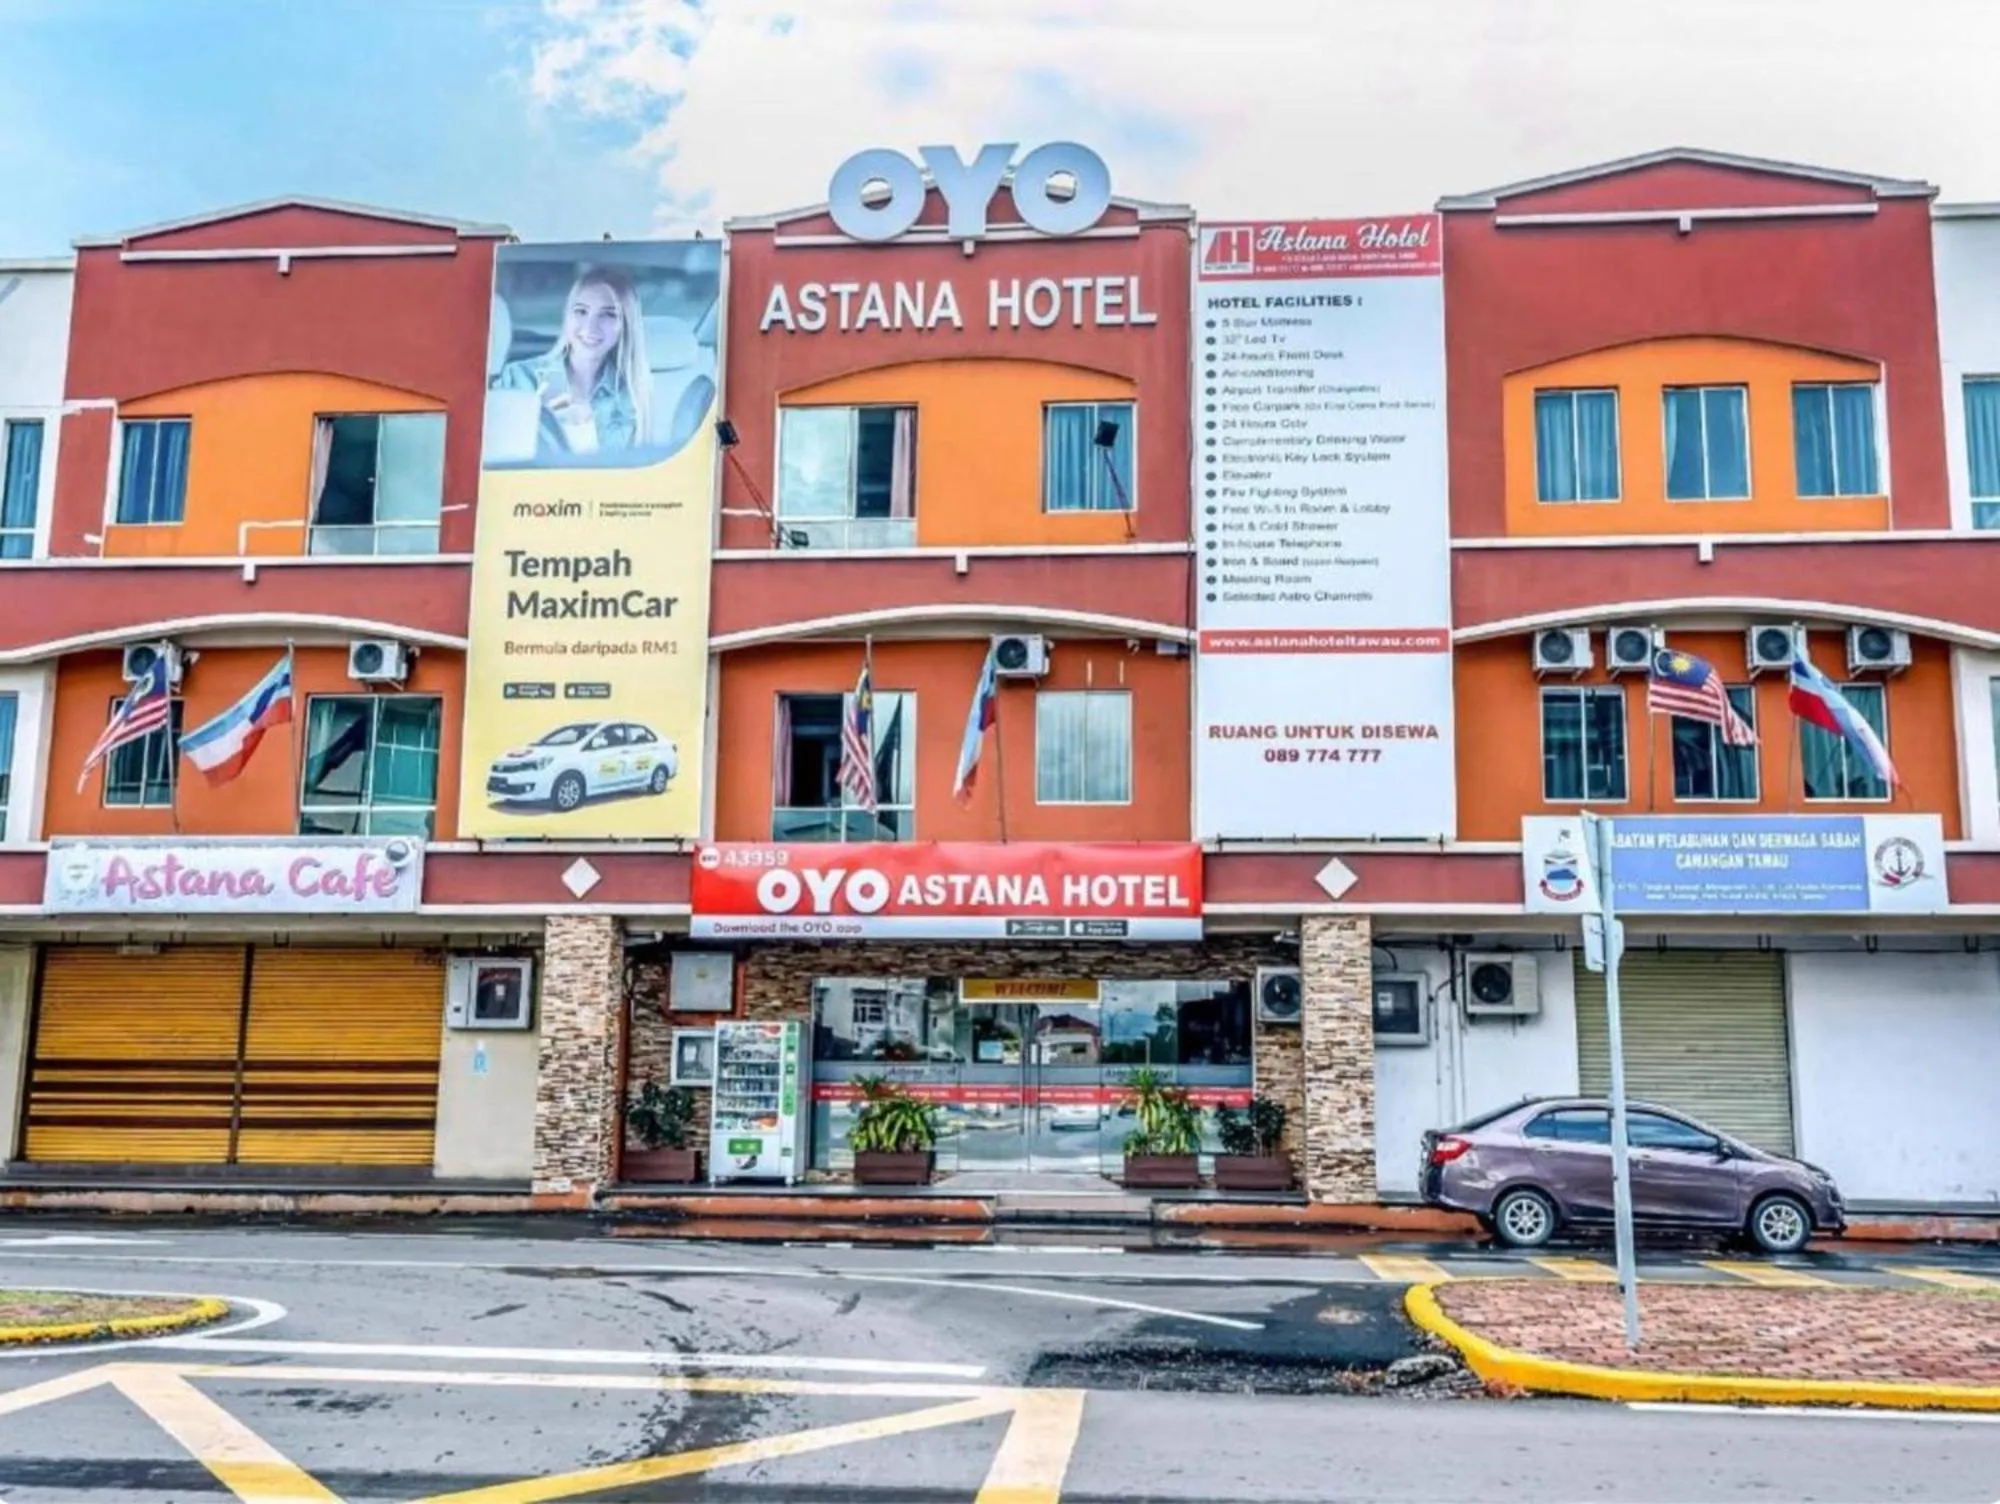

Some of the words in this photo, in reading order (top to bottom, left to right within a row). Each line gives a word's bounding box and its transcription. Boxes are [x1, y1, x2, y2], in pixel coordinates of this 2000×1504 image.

[828, 141, 1112, 242] OYO
[1256, 226, 1349, 252] Astana
[1357, 222, 1431, 249] Hotel
[760, 280, 963, 332] ASTANA
[988, 275, 1158, 329] HOTEL
[1208, 298, 1260, 309] HOTEL
[1265, 295, 1353, 307] FACILITIES
[1285, 453, 1308, 464] Key
[1312, 452, 1341, 462] Lock
[1345, 452, 1391, 463] System
[1300, 486, 1347, 498] System
[513, 498, 582, 517] maxim
[1352, 503, 1391, 515] Lobby
[1259, 522, 1288, 531] Cold
[1291, 522, 1339, 532] Shower
[504, 549, 632, 583] Tempah
[1262, 556, 1298, 566] Board
[1274, 574, 1312, 584] Room
[507, 590, 678, 620] MaximCar
[1208, 634, 1441, 648] www.astanahoteltawau.com
[571, 640, 637, 658] daripada
[642, 640, 678, 655] RM1
[1208, 725, 1278, 739] RUANG
[1285, 725, 1354, 739] UNTUK
[1361, 725, 1439, 739] DISEWA
[1264, 749, 1300, 763] 089
[1306, 749, 1340, 763] 774
[1348, 749, 1382, 763] 777
[724, 850, 789, 867] 43959
[1748, 853, 1788, 869] TAWAU
[101, 853, 275, 904] Astana
[757, 867, 890, 914] OYO
[897, 874, 1049, 907] ASTANA
[1062, 874, 1190, 908] HOTEL
[780, 921, 799, 933] the
[803, 922, 832, 933] OYO
